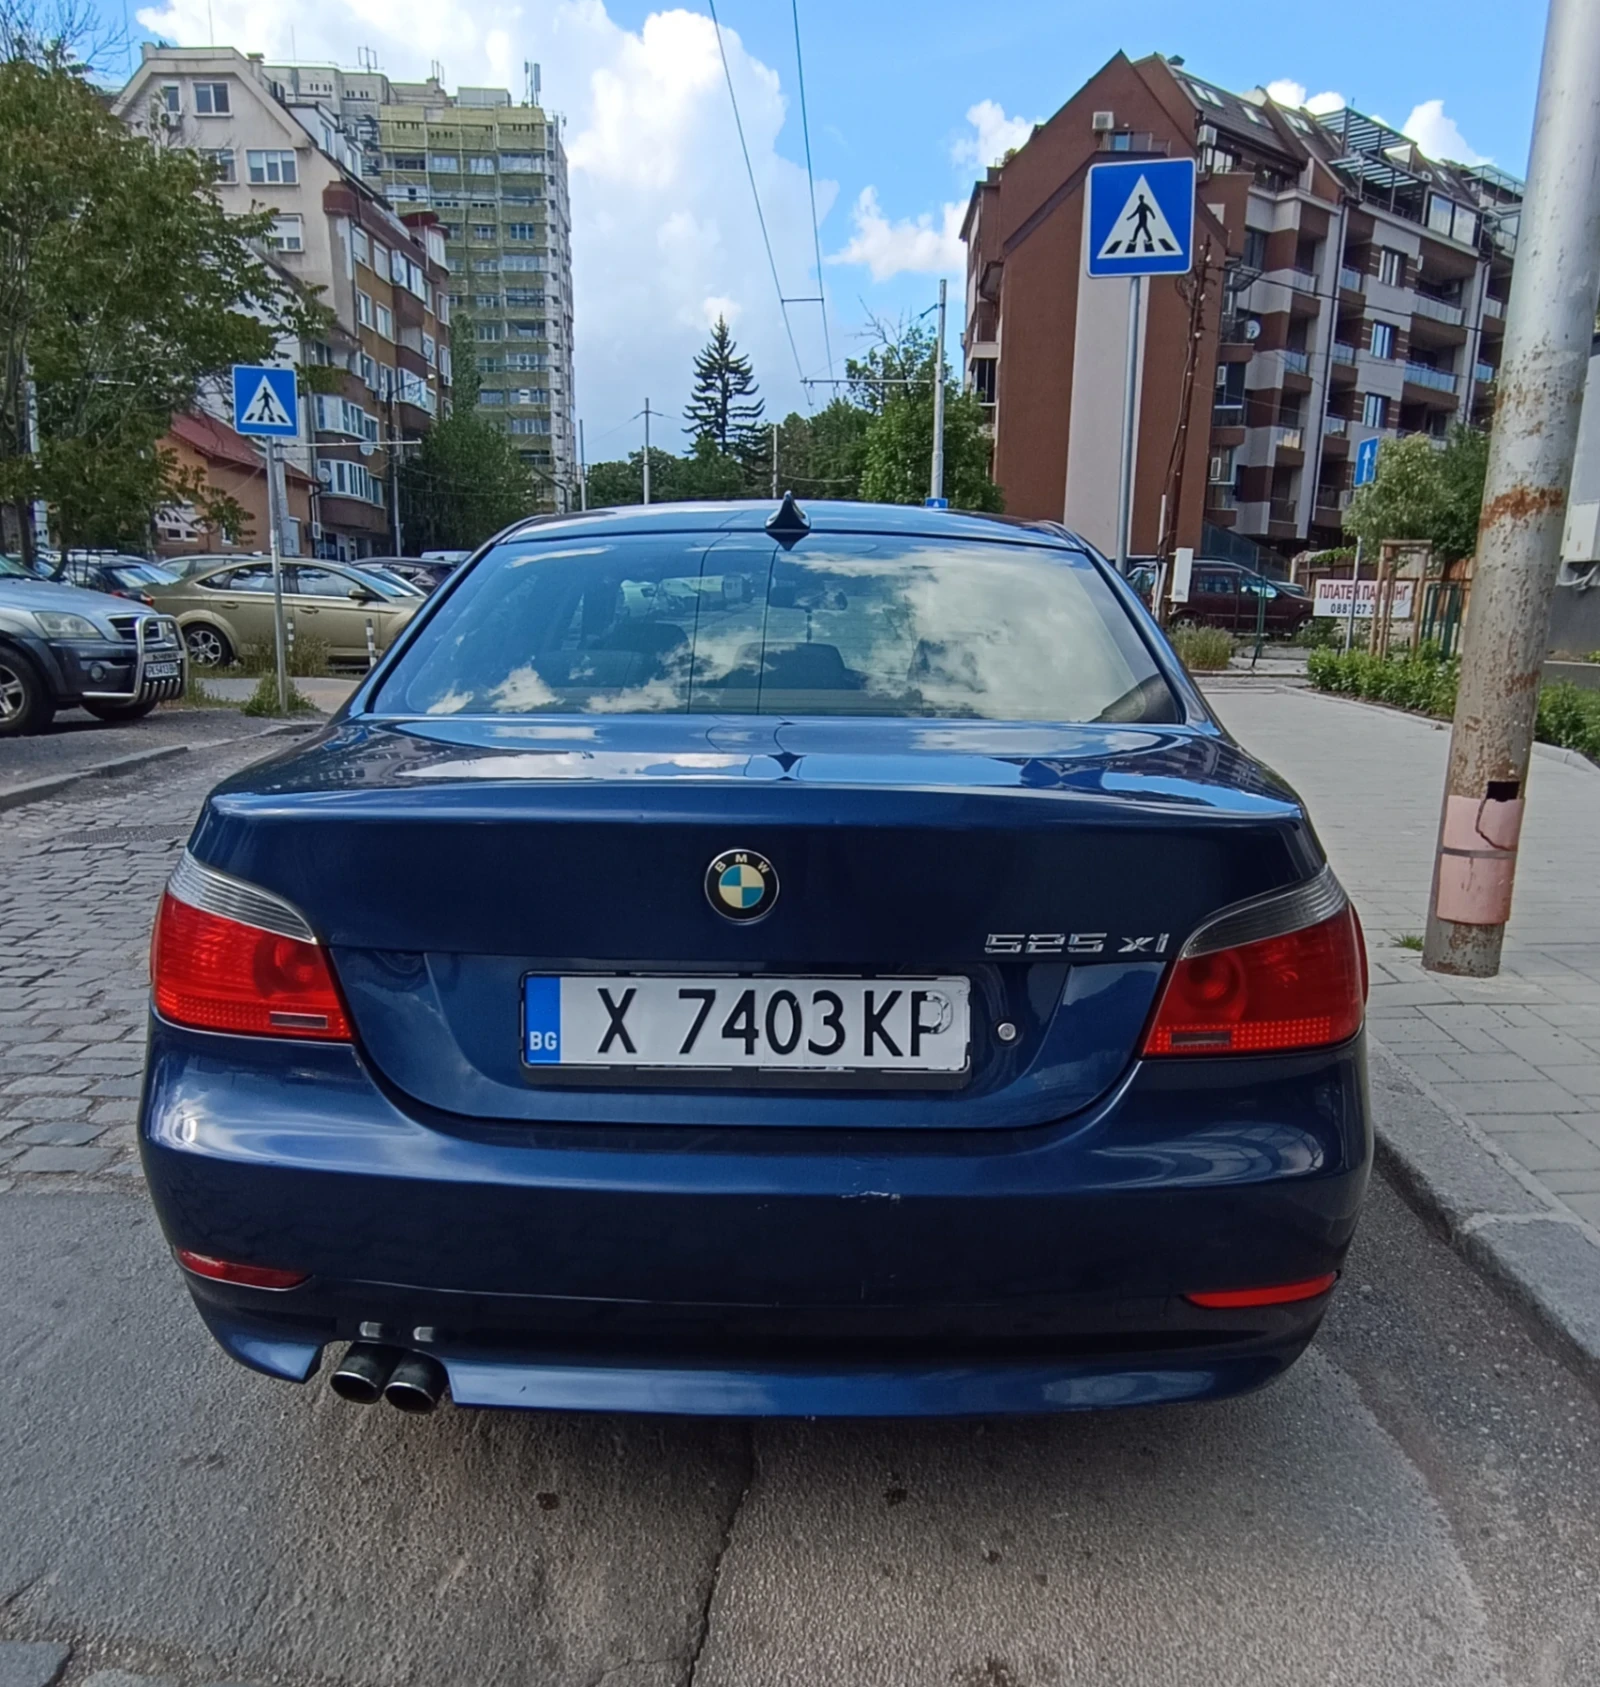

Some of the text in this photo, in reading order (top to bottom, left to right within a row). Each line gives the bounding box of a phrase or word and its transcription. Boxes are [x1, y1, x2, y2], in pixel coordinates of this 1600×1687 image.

[714, 853, 770, 873] BMW
[984, 933, 1107, 953] 525
[678, 989, 846, 1056] 7403
[529, 1031, 557, 1050] BG
